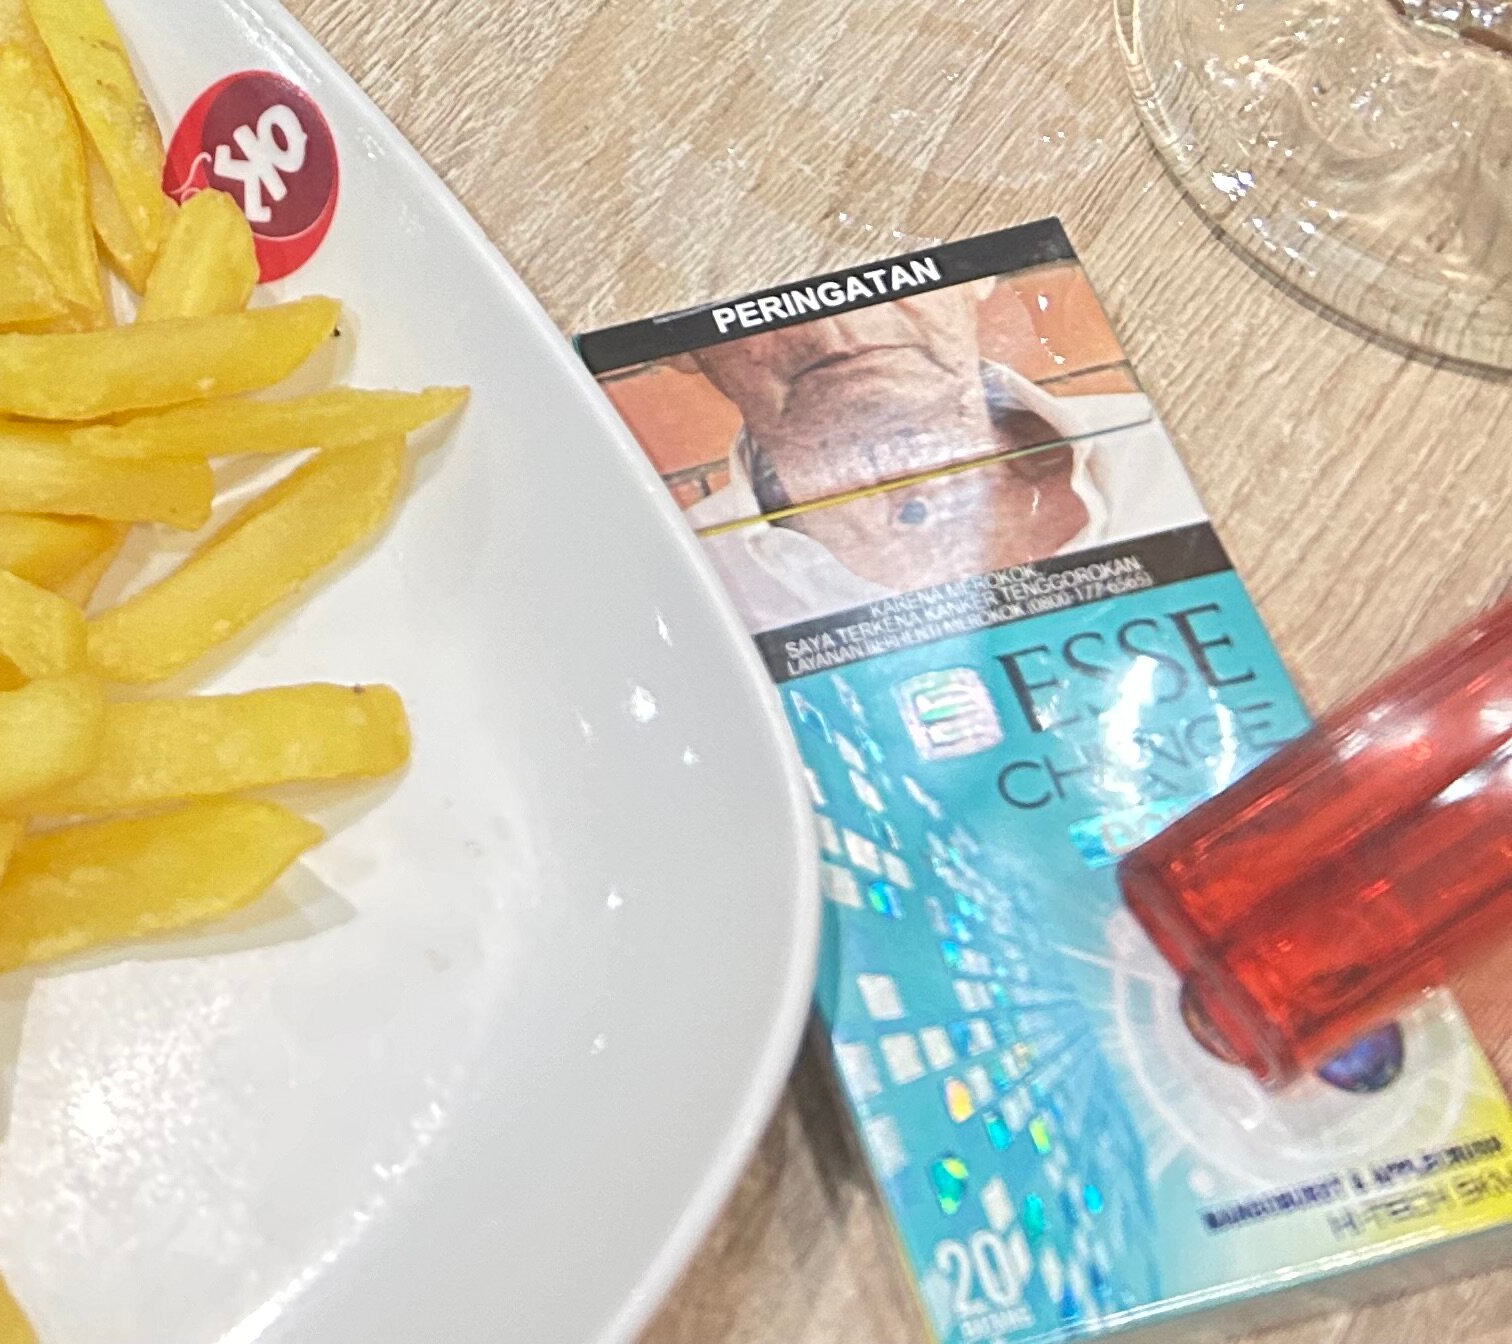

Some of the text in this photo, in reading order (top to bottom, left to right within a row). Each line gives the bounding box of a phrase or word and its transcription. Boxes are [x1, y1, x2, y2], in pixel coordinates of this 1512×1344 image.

[713, 258, 941, 333] PERINGATAN
[785, 632, 833, 659] SAYA
[836, 610, 922, 644] TERKENA
[787, 645, 864, 675] LAYANAN
[999, 601, 1256, 733] ESSE
[937, 1232, 1025, 1310] 20
